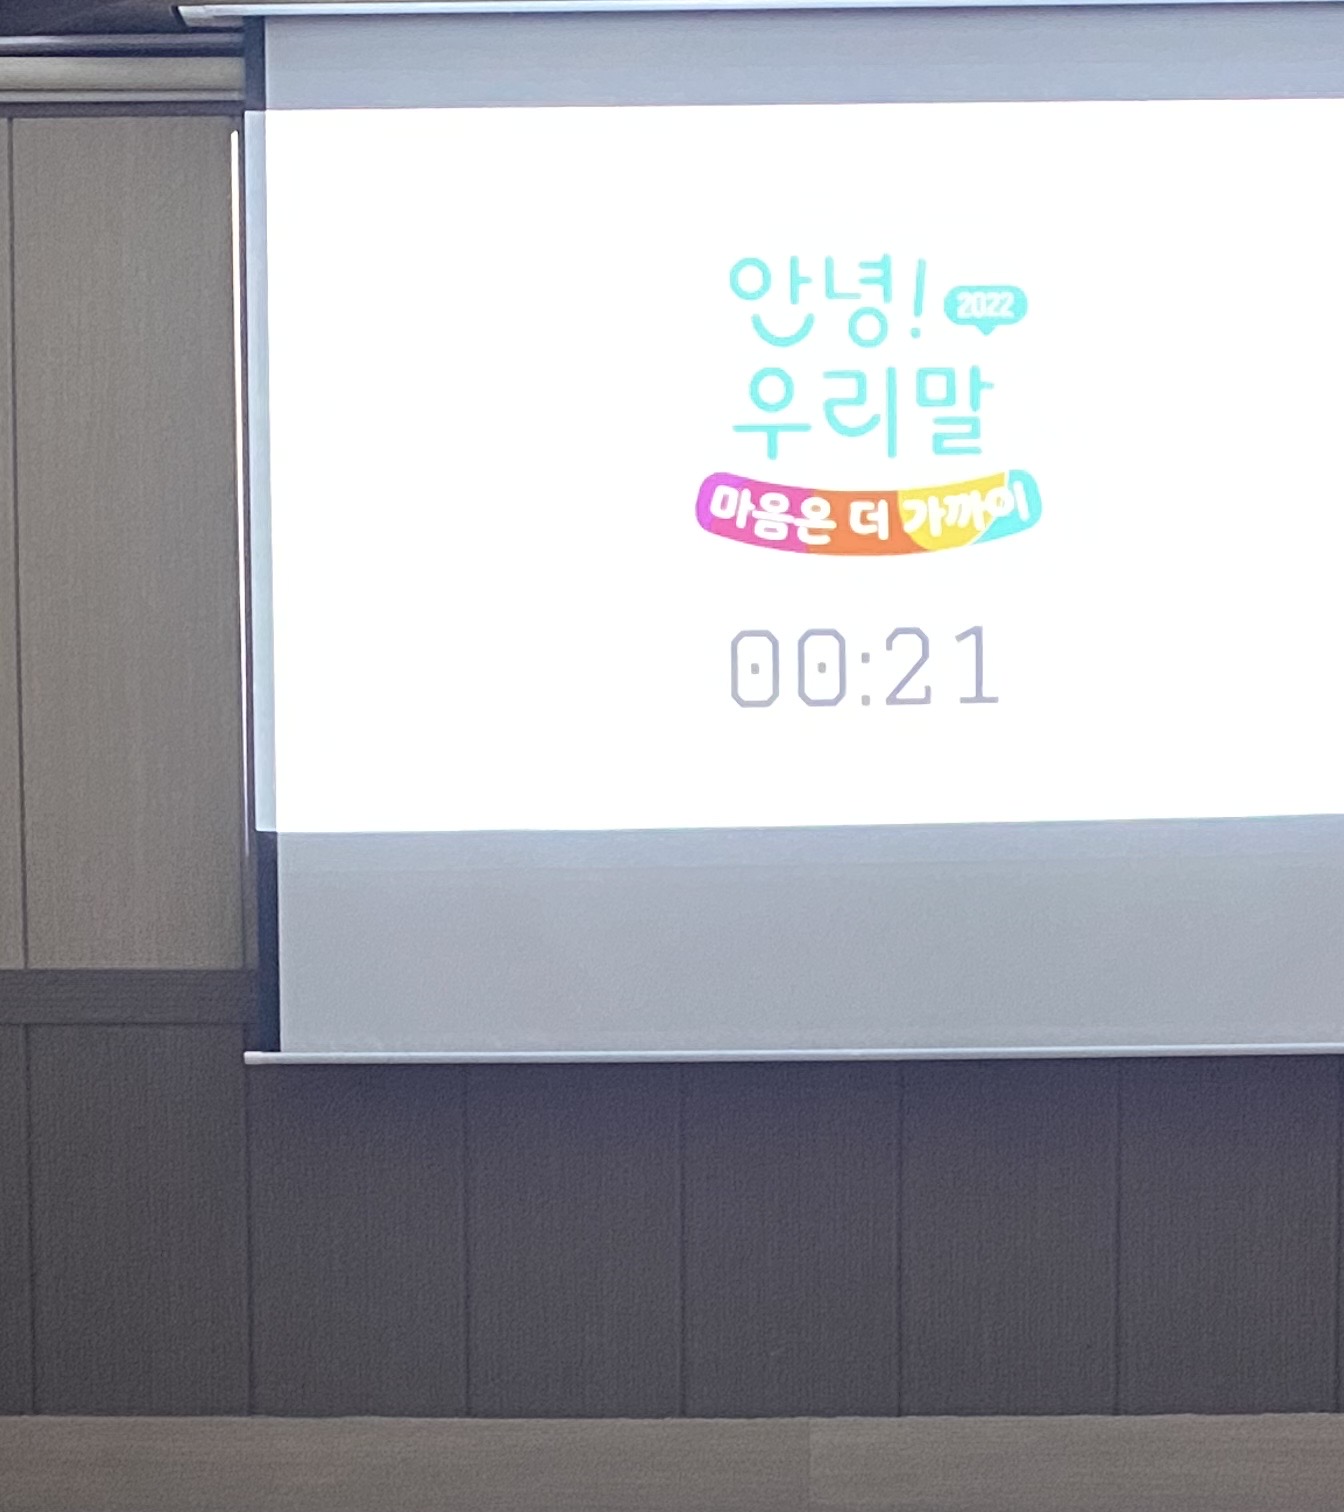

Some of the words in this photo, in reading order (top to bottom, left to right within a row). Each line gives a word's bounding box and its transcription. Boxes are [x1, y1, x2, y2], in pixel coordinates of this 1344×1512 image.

[729, 253, 927, 348] 안녕!
[956, 291, 1016, 319] 2022
[732, 365, 995, 460] 우리말
[709, 484, 838, 545] 마음은
[848, 498, 890, 541] 더
[902, 480, 1030, 538] 가까이
[730, 624, 1000, 708] 00:21
